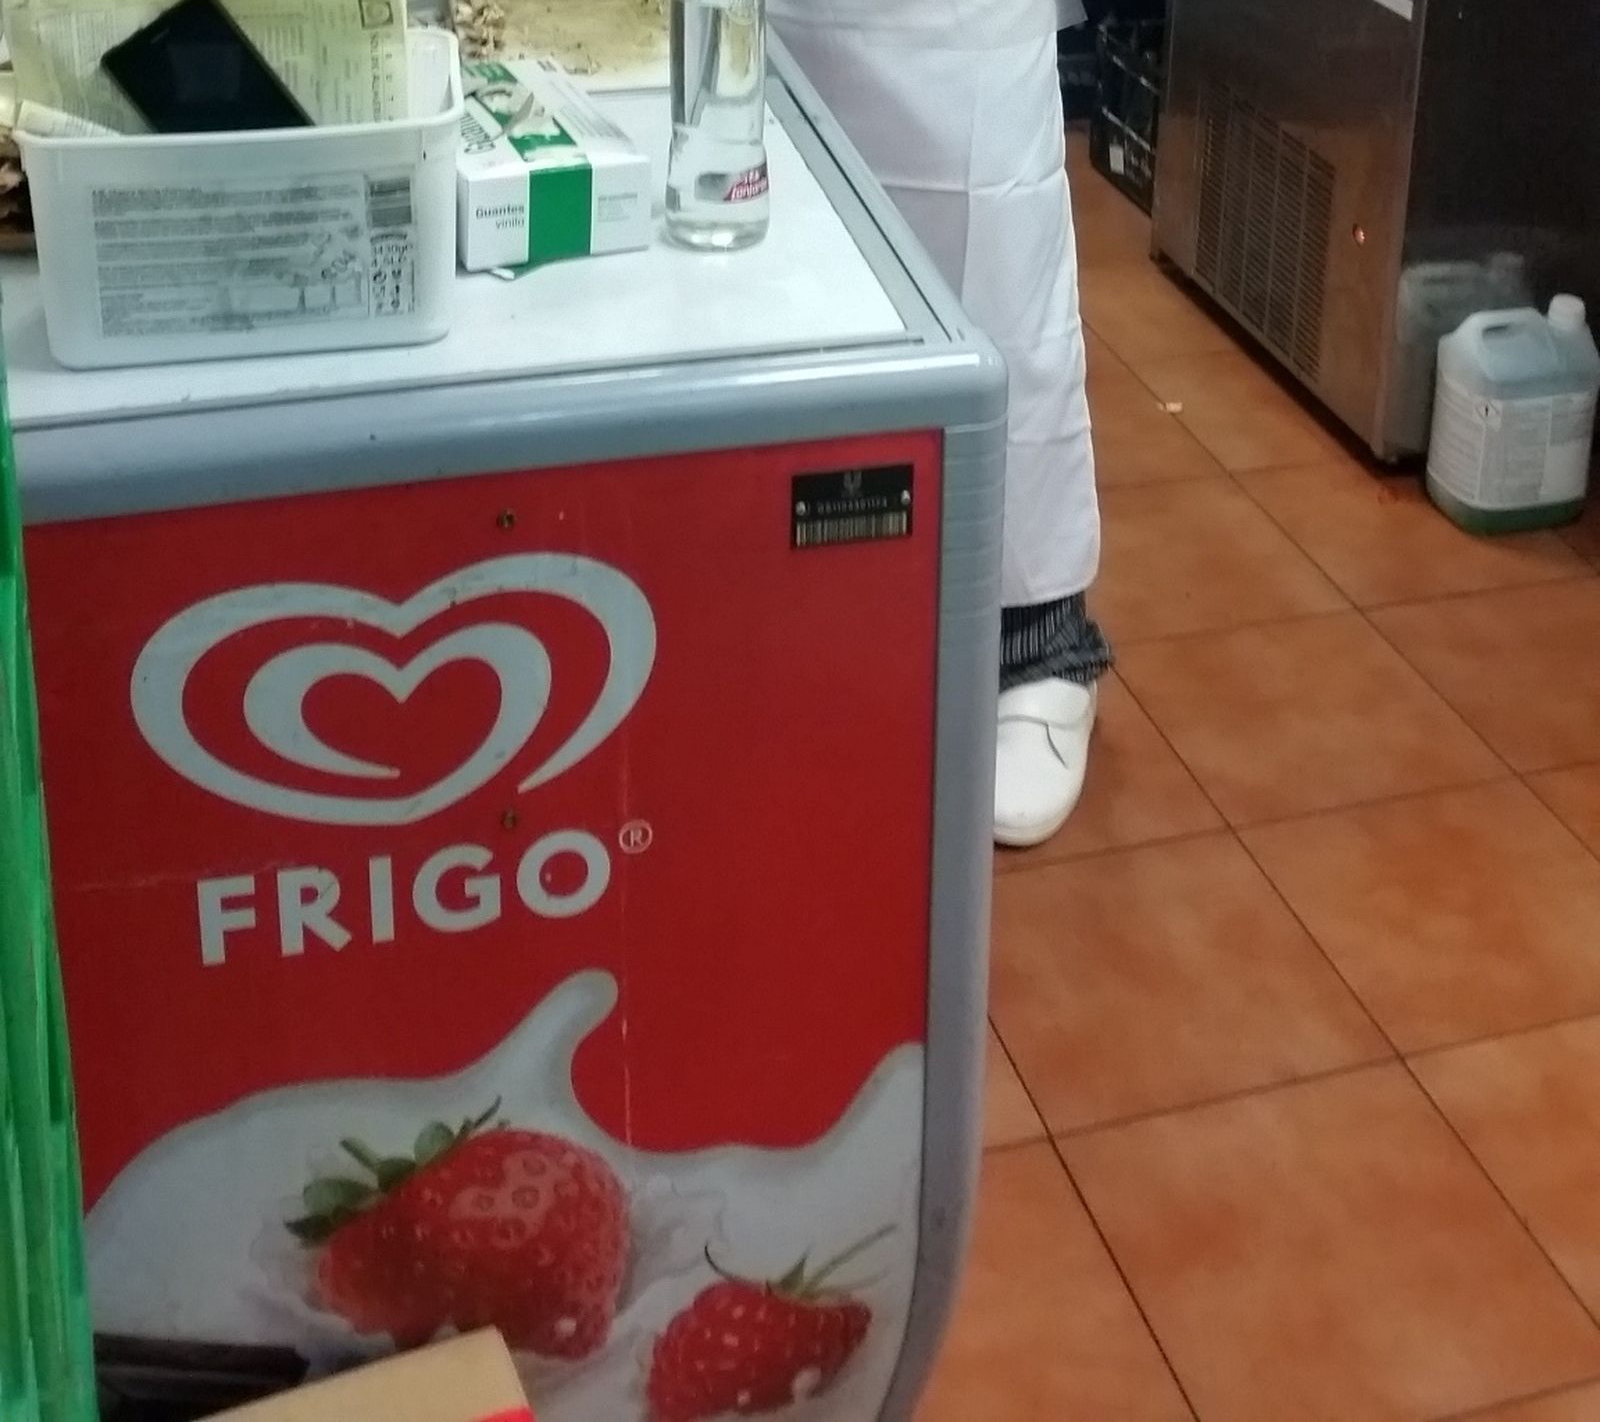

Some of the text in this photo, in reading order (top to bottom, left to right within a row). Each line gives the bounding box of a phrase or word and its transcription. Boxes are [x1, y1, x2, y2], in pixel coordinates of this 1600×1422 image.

[475, 204, 525, 220] Guantes
[494, 217, 525, 229] vinilo
[197, 829, 611, 967] FRIGO
